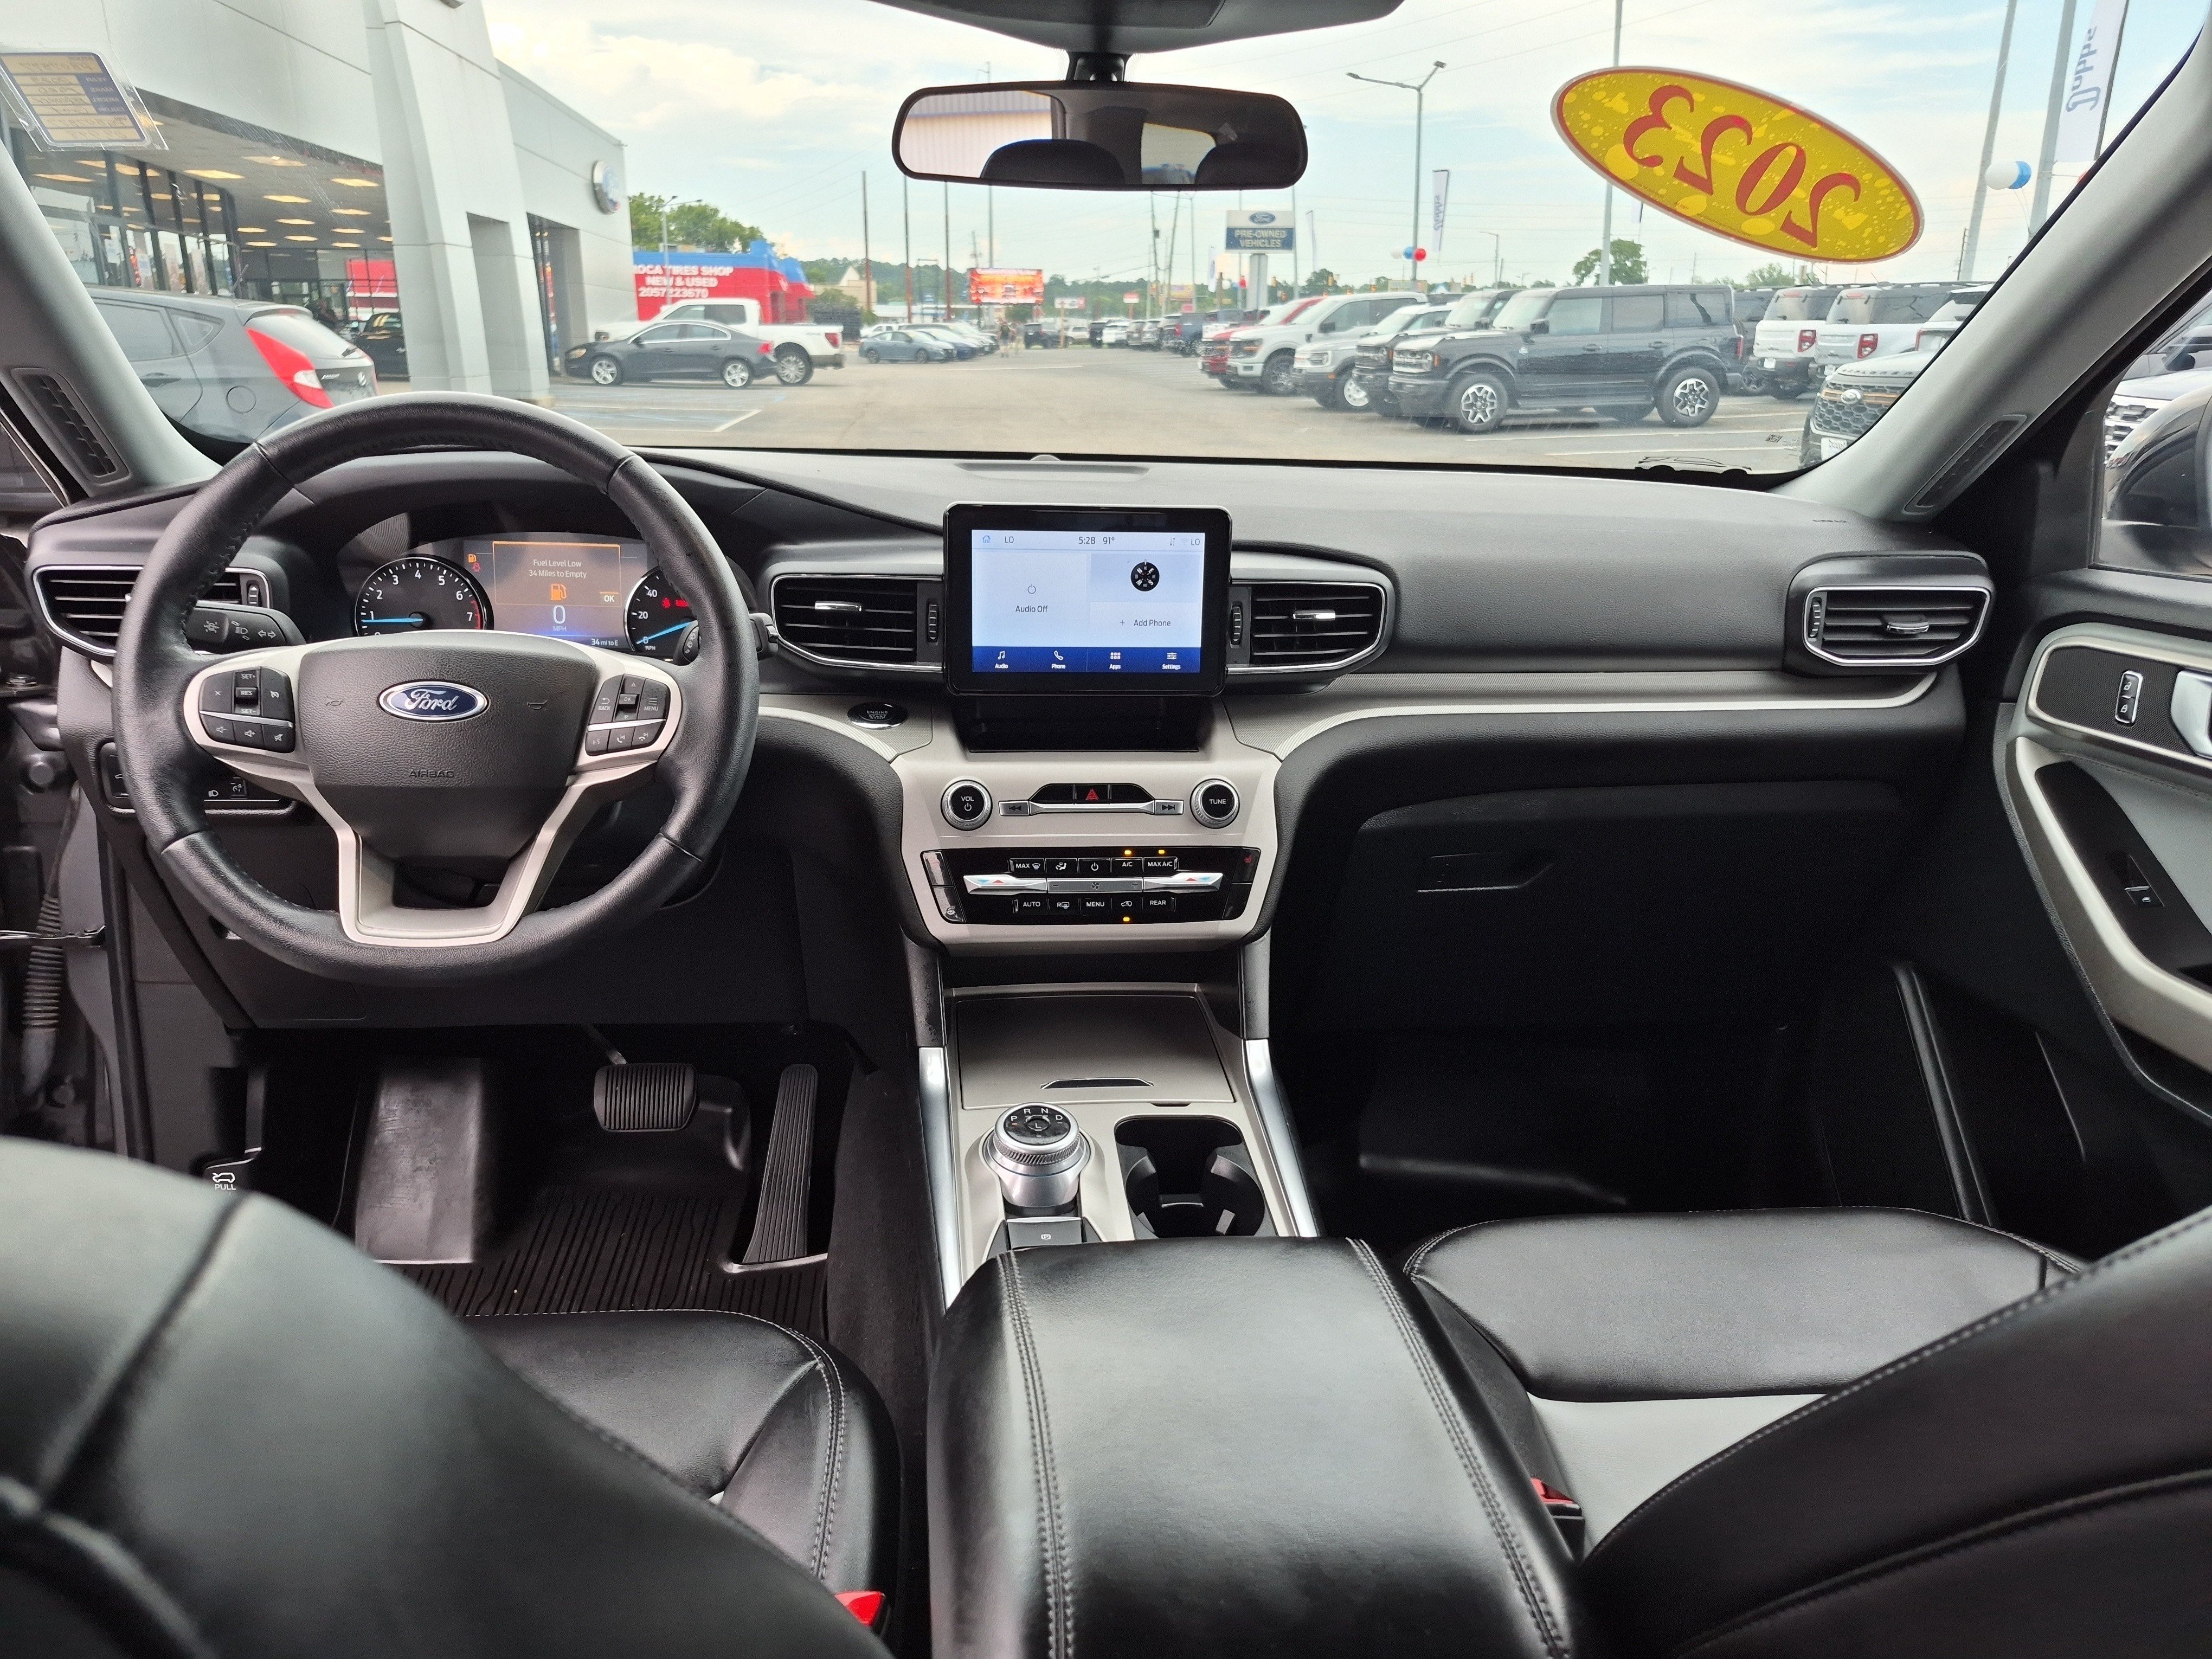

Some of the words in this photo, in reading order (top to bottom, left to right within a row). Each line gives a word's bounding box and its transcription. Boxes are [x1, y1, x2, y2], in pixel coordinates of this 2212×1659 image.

[1234, 229, 1287, 239] PRE-OWNED
[1239, 239, 1282, 248] VEHICLES
[661, 265, 699, 275] TIRES
[700, 266, 734, 276] SHOP
[645, 275, 674, 286] NEW
[674, 276, 685, 287] &
[685, 276, 718, 288] USED
[1078, 536, 1096, 545] 5:28
[1103, 537, 1115, 545] 91°
[415, 569, 422, 580] 4
[565, 571, 587, 579] Empty
[393, 575, 399, 585] 3
[438, 575, 445, 586] 5
[376, 589, 383, 600] 2
[456, 590, 463, 601] 6
[647, 589, 658, 597] 40
[369, 610, 375, 620] 1
[466, 612, 473, 622] 7
[553, 605, 566, 624] 0
[638, 611, 648, 619] 20
[404, 689, 459, 711] Ford
[409, 769, 455, 779] AIRBAG
